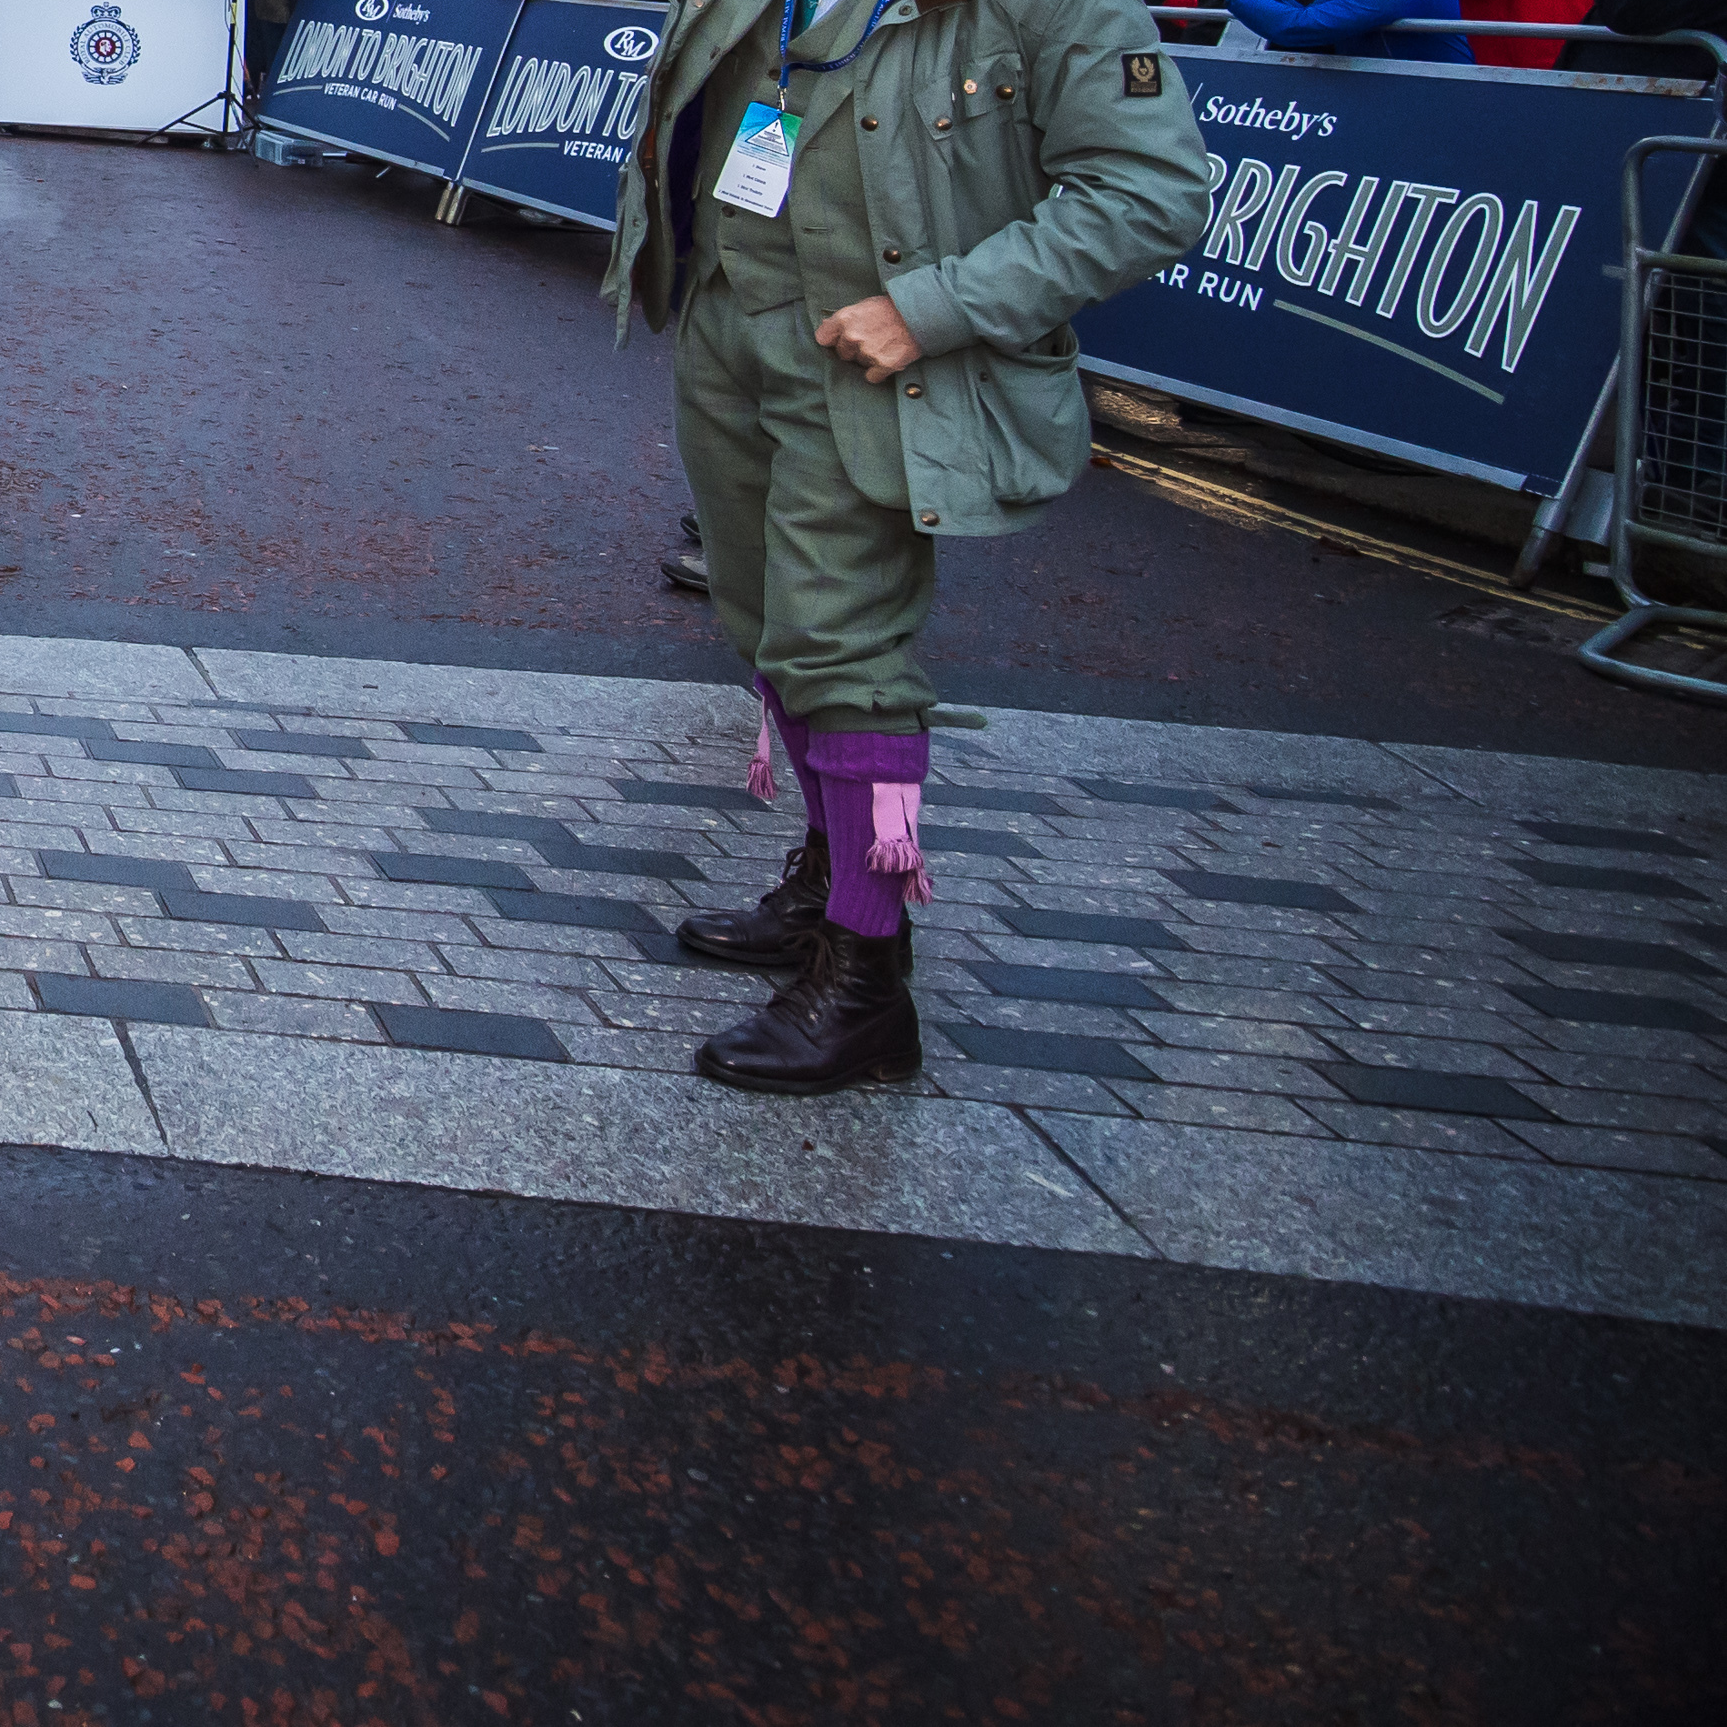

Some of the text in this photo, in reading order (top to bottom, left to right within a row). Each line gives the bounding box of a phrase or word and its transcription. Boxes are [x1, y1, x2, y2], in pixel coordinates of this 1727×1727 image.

[392, 3, 431, 26] Sotheby's
[276, 19, 484, 128] LONDON TO BRIGHTON
[323, 82, 398, 111] VETERAN CAR RUN
[485, 55, 615, 138] LONDON
[1199, 95, 1338, 141] Sotheby's
[563, 140, 624, 164] VETERAN
[1197, 271, 1264, 312] RUN
